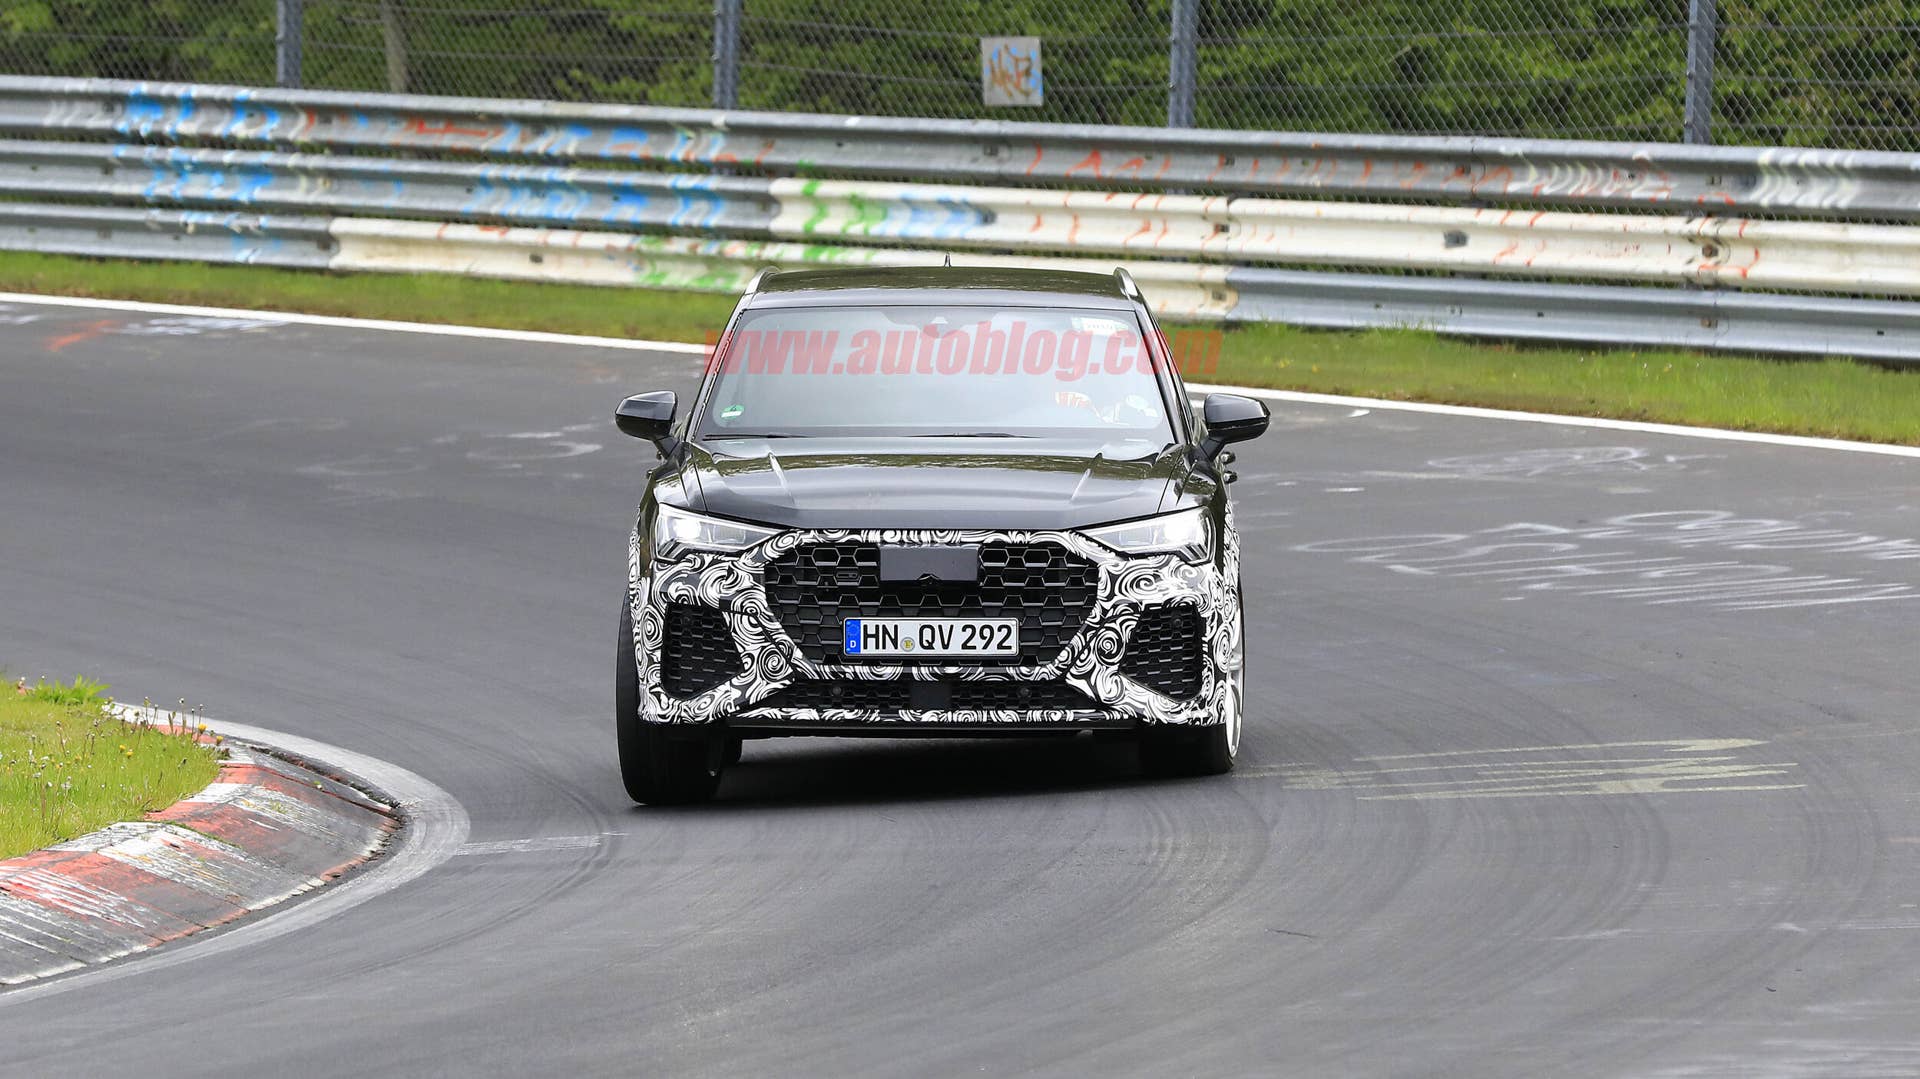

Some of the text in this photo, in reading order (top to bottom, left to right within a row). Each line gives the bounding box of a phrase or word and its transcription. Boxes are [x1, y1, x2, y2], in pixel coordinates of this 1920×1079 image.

[850, 640, 857, 648] D
[863, 624, 1012, 650] HN QV 292
